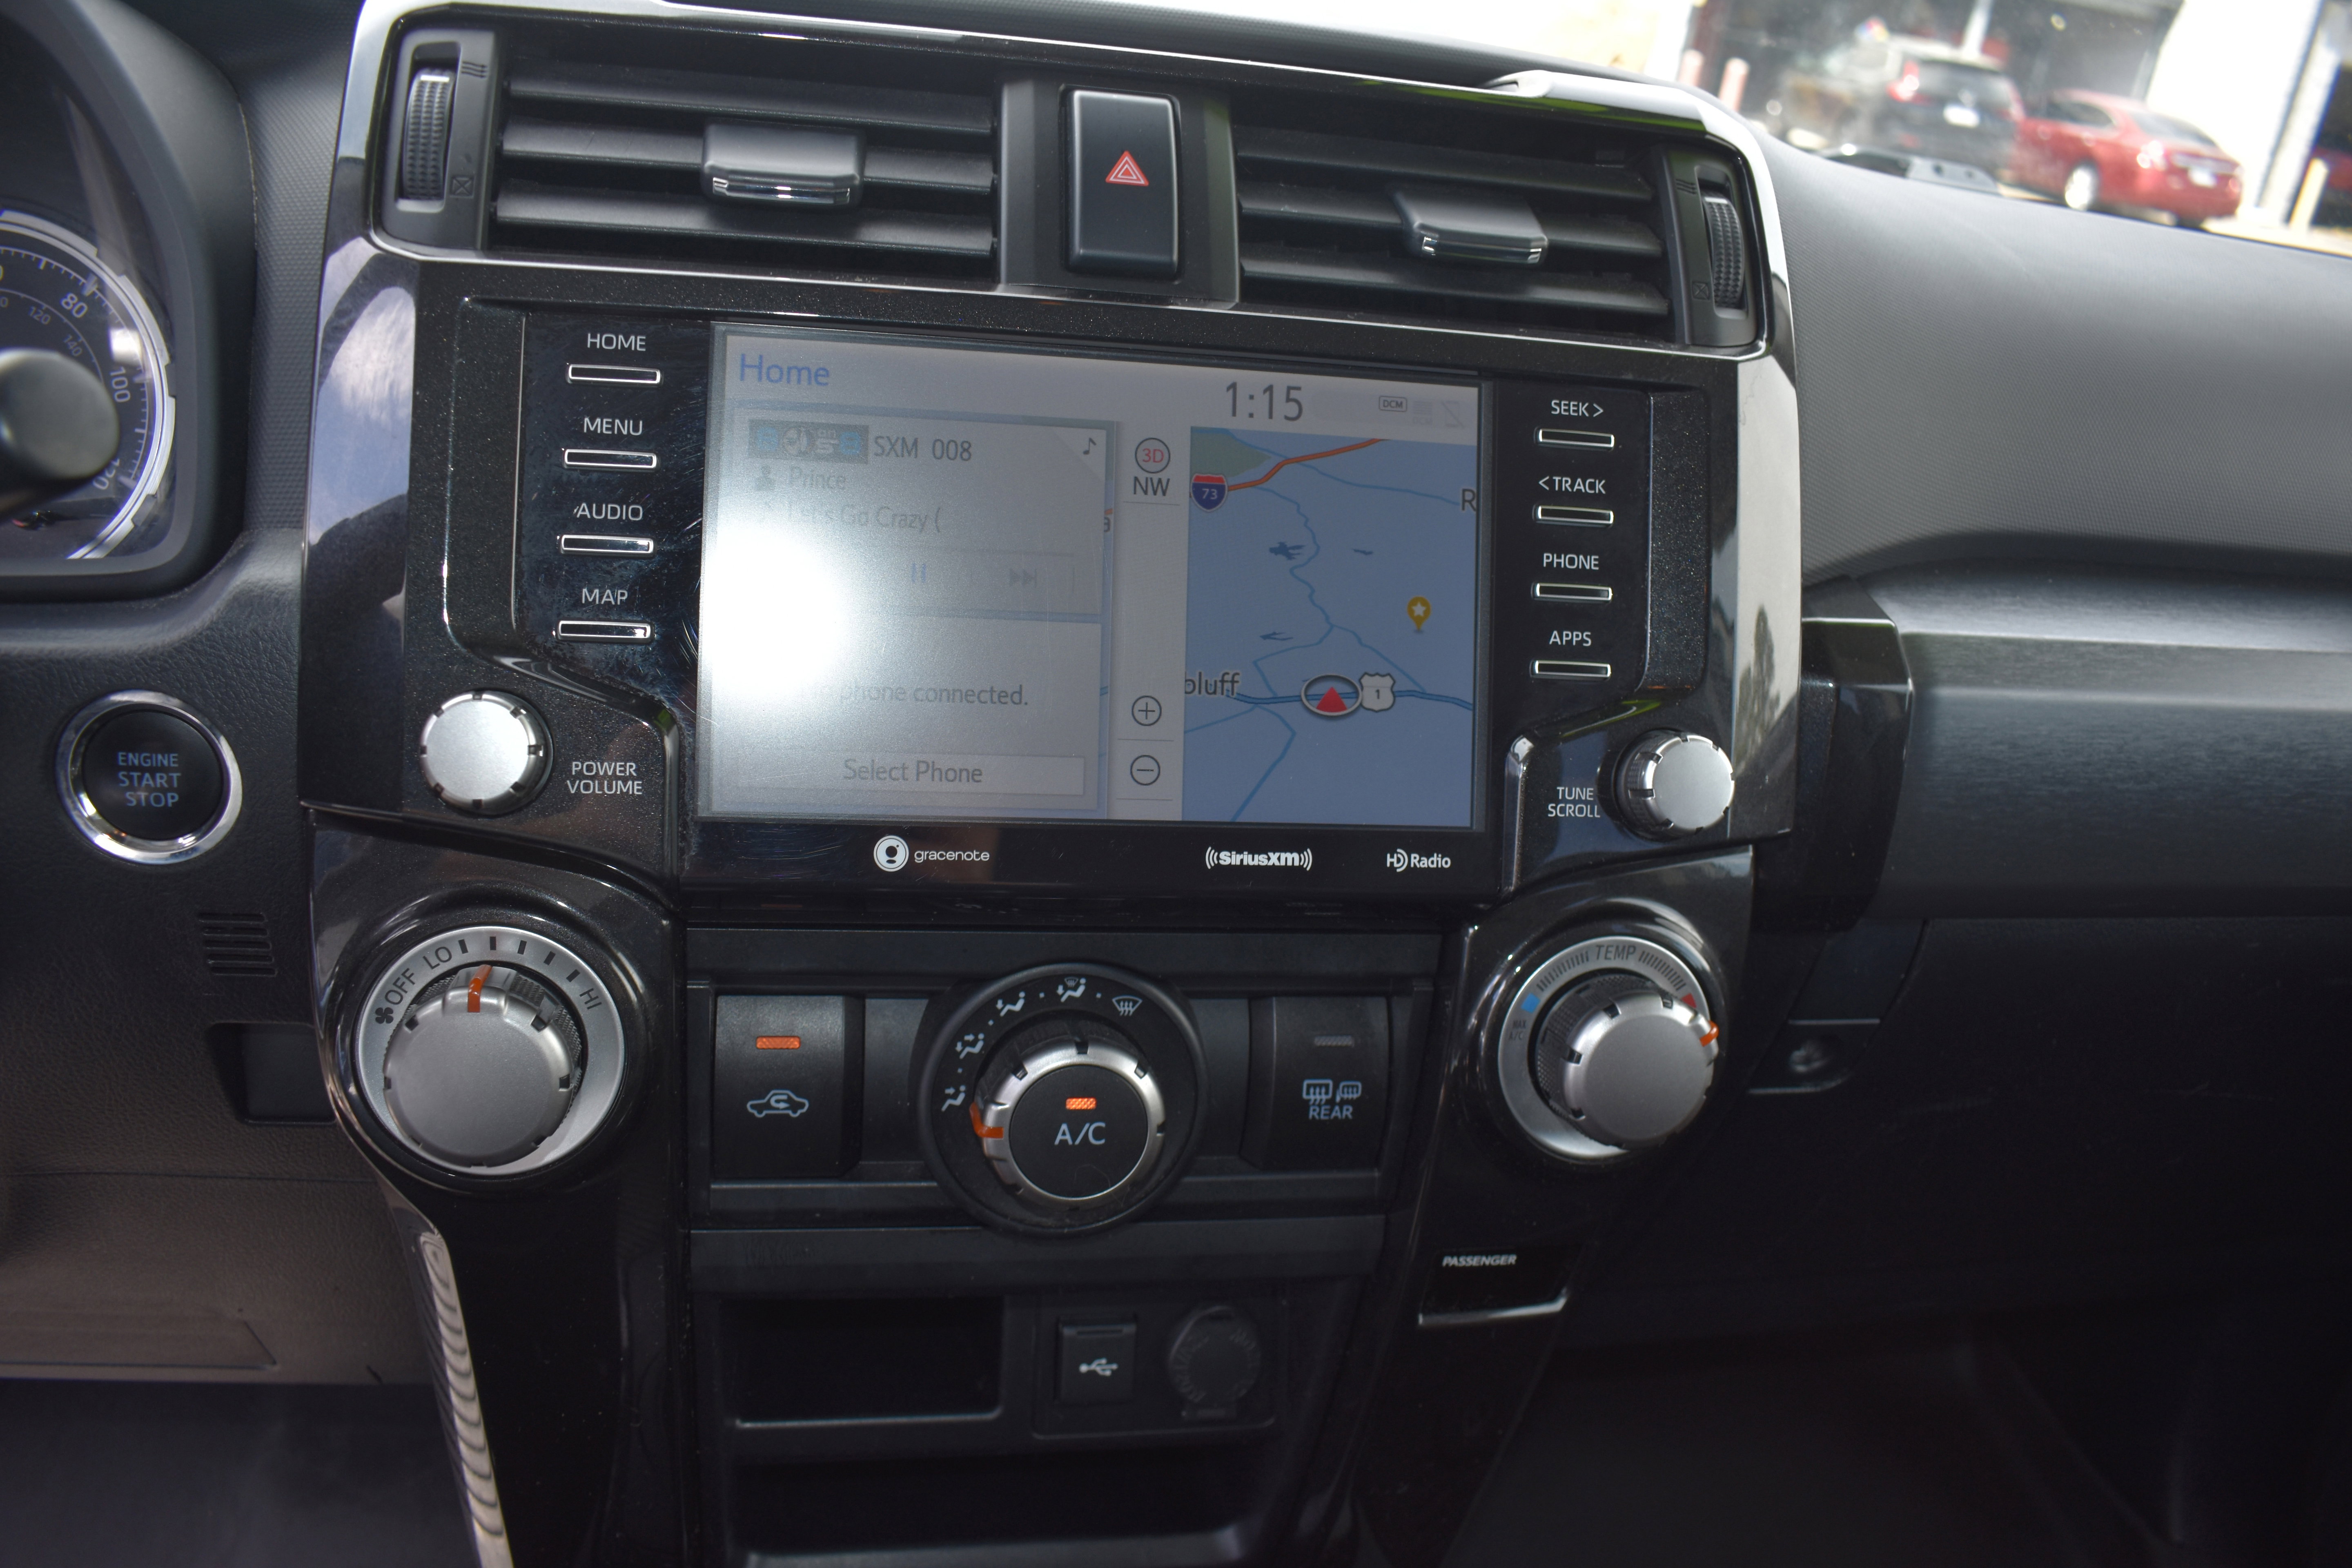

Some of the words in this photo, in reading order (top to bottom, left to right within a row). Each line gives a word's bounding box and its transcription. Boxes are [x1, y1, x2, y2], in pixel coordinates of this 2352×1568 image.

[60, 292, 88, 318] 80
[28, 306, 51, 325] 120
[63, 334, 82, 356] 140
[587, 333, 646, 351] HOME
[740, 354, 830, 386] Home
[109, 366, 131, 403] 100
[1226, 381, 1303, 422] 1:15
[1383, 399, 1403, 409] DCM
[584, 418, 643, 435] MENU
[874, 435, 918, 459] SXM
[932, 439, 972, 461] 008
[1143, 448, 1164, 463] 3D
[788, 466, 846, 490] Prince
[1133, 476, 1170, 497] NW
[1202, 488, 1218, 499] 73
[577, 503, 643, 521] AUDIO
[876, 506, 928, 533] Crazy
[1543, 553, 1599, 570] PHONE
[582, 588, 628, 606] MAP
[1549, 630, 1592, 646] APPS
[1185, 671, 1240, 696] bluff
[914, 685, 1028, 706] connected.
[117, 751, 179, 767] ENGINE
[572, 762, 637, 776] POWER
[843, 758, 908, 782] Select
[915, 760, 983, 783] Phone
[118, 771, 181, 788] START
[567, 780, 643, 795] VOLUME
[125, 791, 179, 808] STOP
[1557, 786, 1594, 800] TUNE
[1548, 803, 1601, 818] SCROLL
[914, 849, 990, 863] gracenote
[1410, 853, 1451, 869] Radio
[423, 946, 452, 970] LO
[1595, 944, 1637, 961] TEMP
[384, 968, 417, 1006] OFF
[579, 988, 602, 1010] HI
[1308, 1105, 1353, 1119] REAR
[1054, 1122, 1105, 1145] A/C
[1442, 1254, 1517, 1267] PASSENGER
